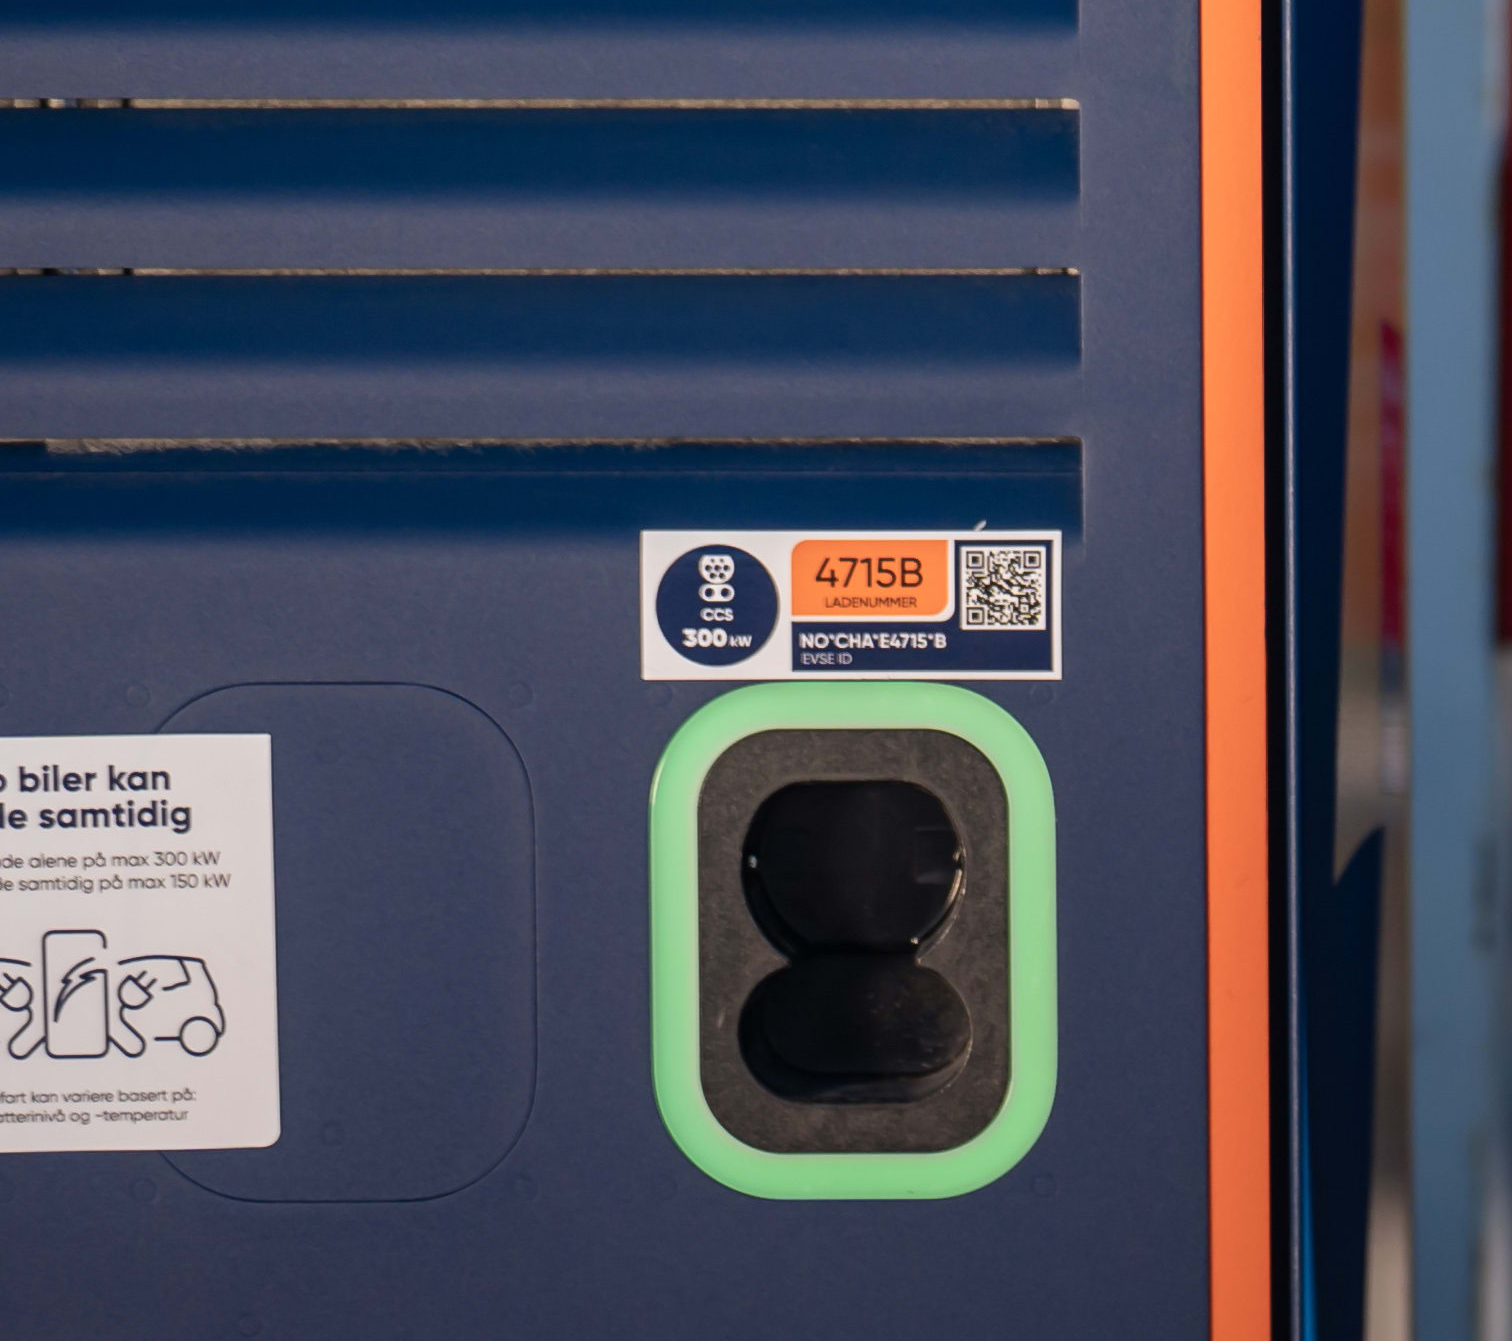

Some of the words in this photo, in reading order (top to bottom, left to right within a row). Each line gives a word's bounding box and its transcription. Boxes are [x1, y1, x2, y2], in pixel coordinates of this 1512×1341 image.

[815, 557, 924, 588] 4715B
[825, 597, 917, 608] LADENUMMER
[700, 607, 734, 622] CCS
[681, 628, 728, 648] 300
[802, 653, 835, 665] EVSE
[838, 653, 853, 665] ID
[19, 765, 97, 792] biler
[108, 765, 172, 791] kan
[39, 800, 192, 834] samtidig
[83, 852, 106, 870] på
[111, 855, 149, 867] max
[154, 852, 188, 866] 300
[193, 851, 220, 865] kW
[19, 874, 93, 893] samtidig
[99, 874, 123, 892] på
[128, 877, 166, 889] max
[171, 874, 198, 888] 150
[204, 874, 231, 888] kW
[31, 1091, 58, 1103] kan
[63, 1091, 114, 1102] variere
[118, 1090, 167, 1102] basert
[70, 1112, 91, 1124] og
